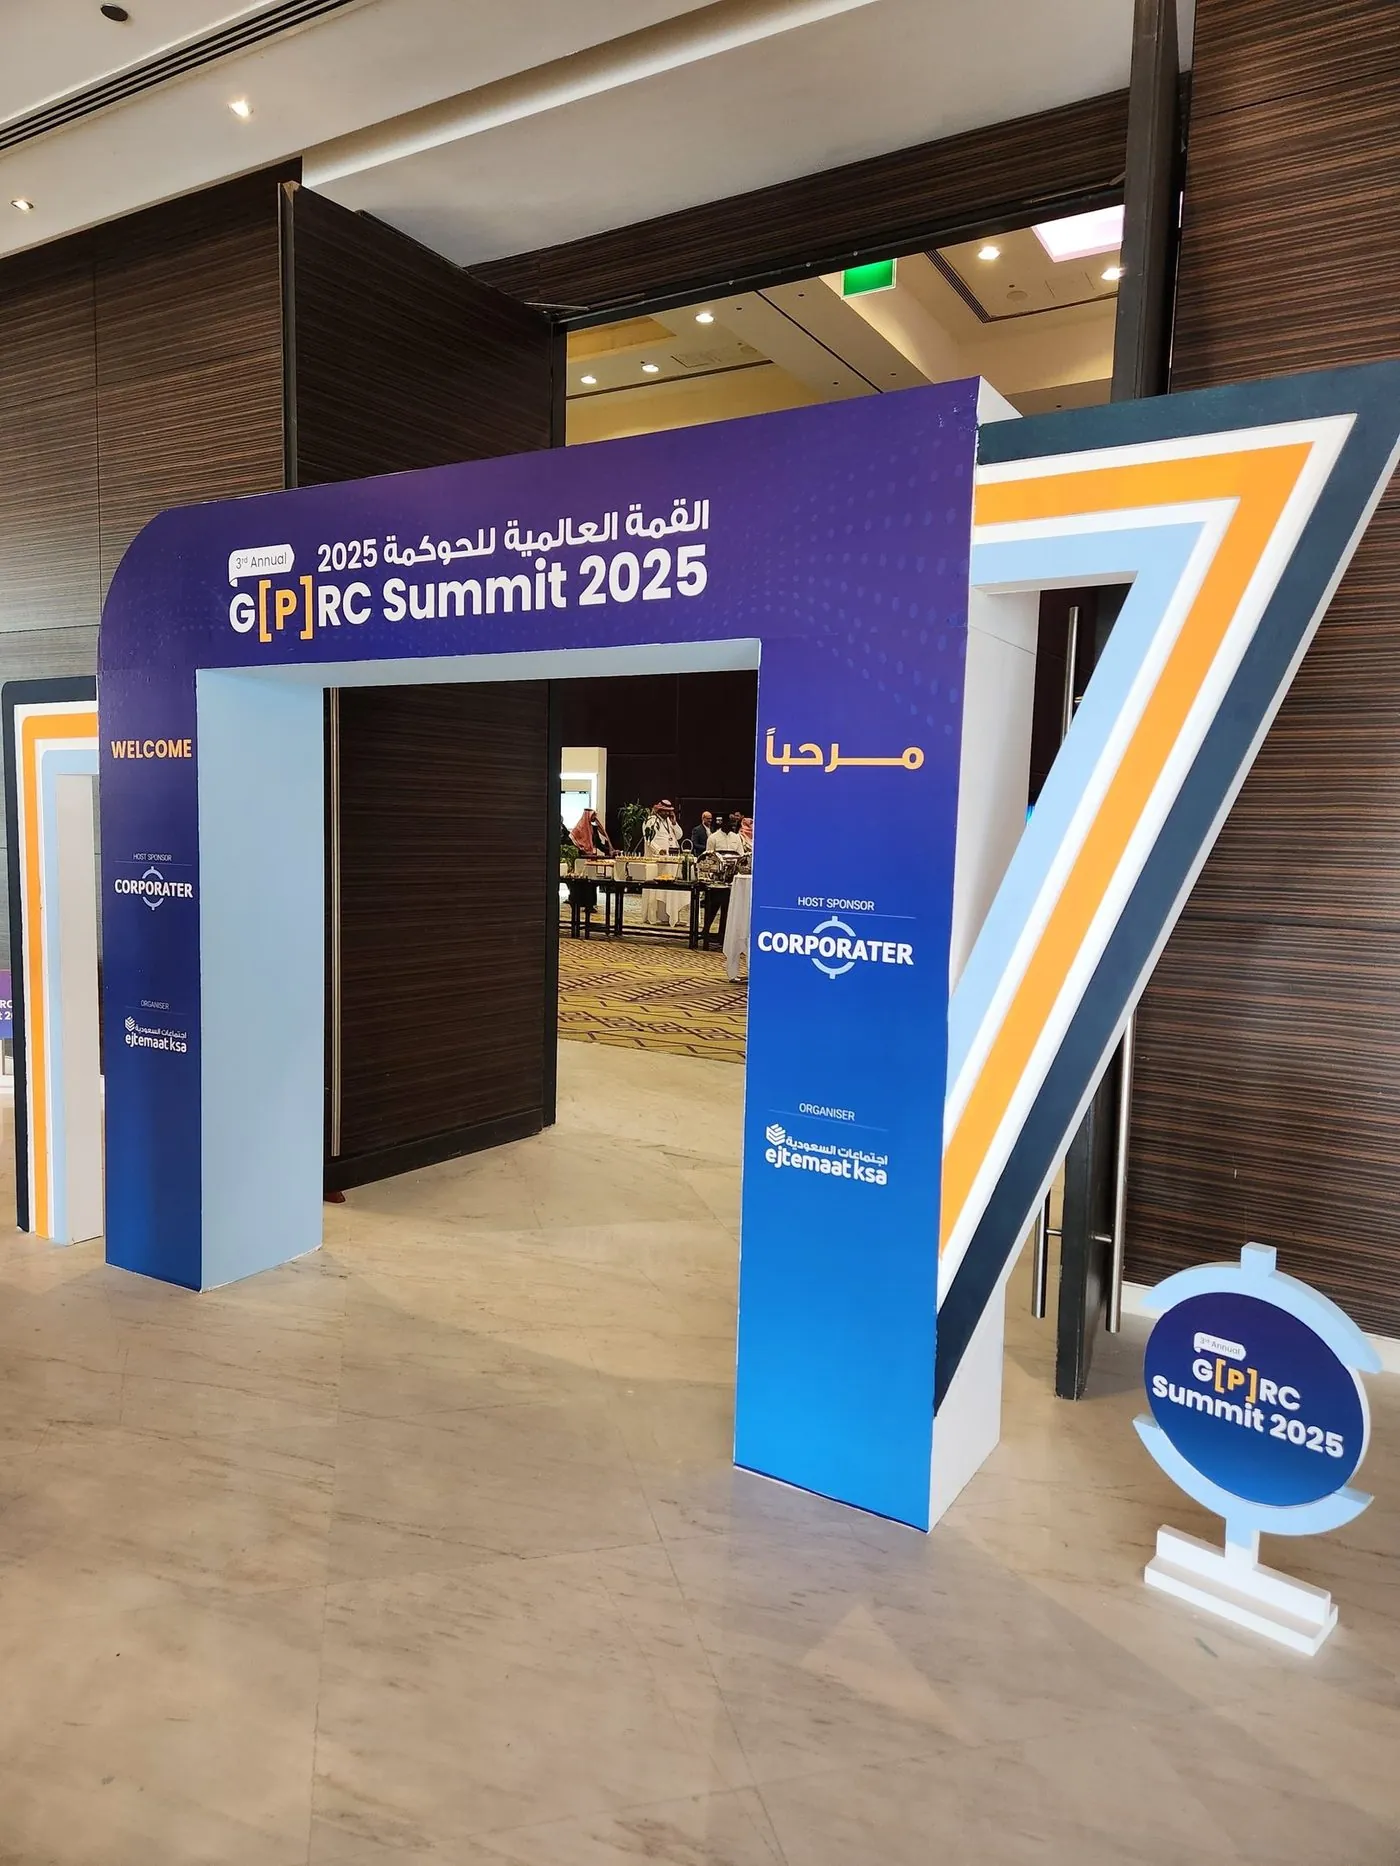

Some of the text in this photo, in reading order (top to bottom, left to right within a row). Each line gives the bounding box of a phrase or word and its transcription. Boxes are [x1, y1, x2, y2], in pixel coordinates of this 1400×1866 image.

[317, 498, 710, 573] القمة العالمية للحوكمة 2025
[250, 552, 287, 568] Annual
[229, 544, 708, 643] G[P]RC Summit 2025
[111, 739, 193, 760] WELCOME
[133, 853, 173, 862] HOST SPONSOR
[114, 879, 194, 898] CORPORATER
[797, 896, 875, 911] HOST SPONSOR
[757, 931, 914, 966] CORPORATER
[140, 999, 170, 1010] ORGANISER
[798, 1102, 856, 1121] ORGANISER
[785, 1135, 889, 1167] اجتماعات السعودية
[1211, 1339, 1241, 1356] Annual
[1152, 1375, 1344, 1458] Summit 2025
